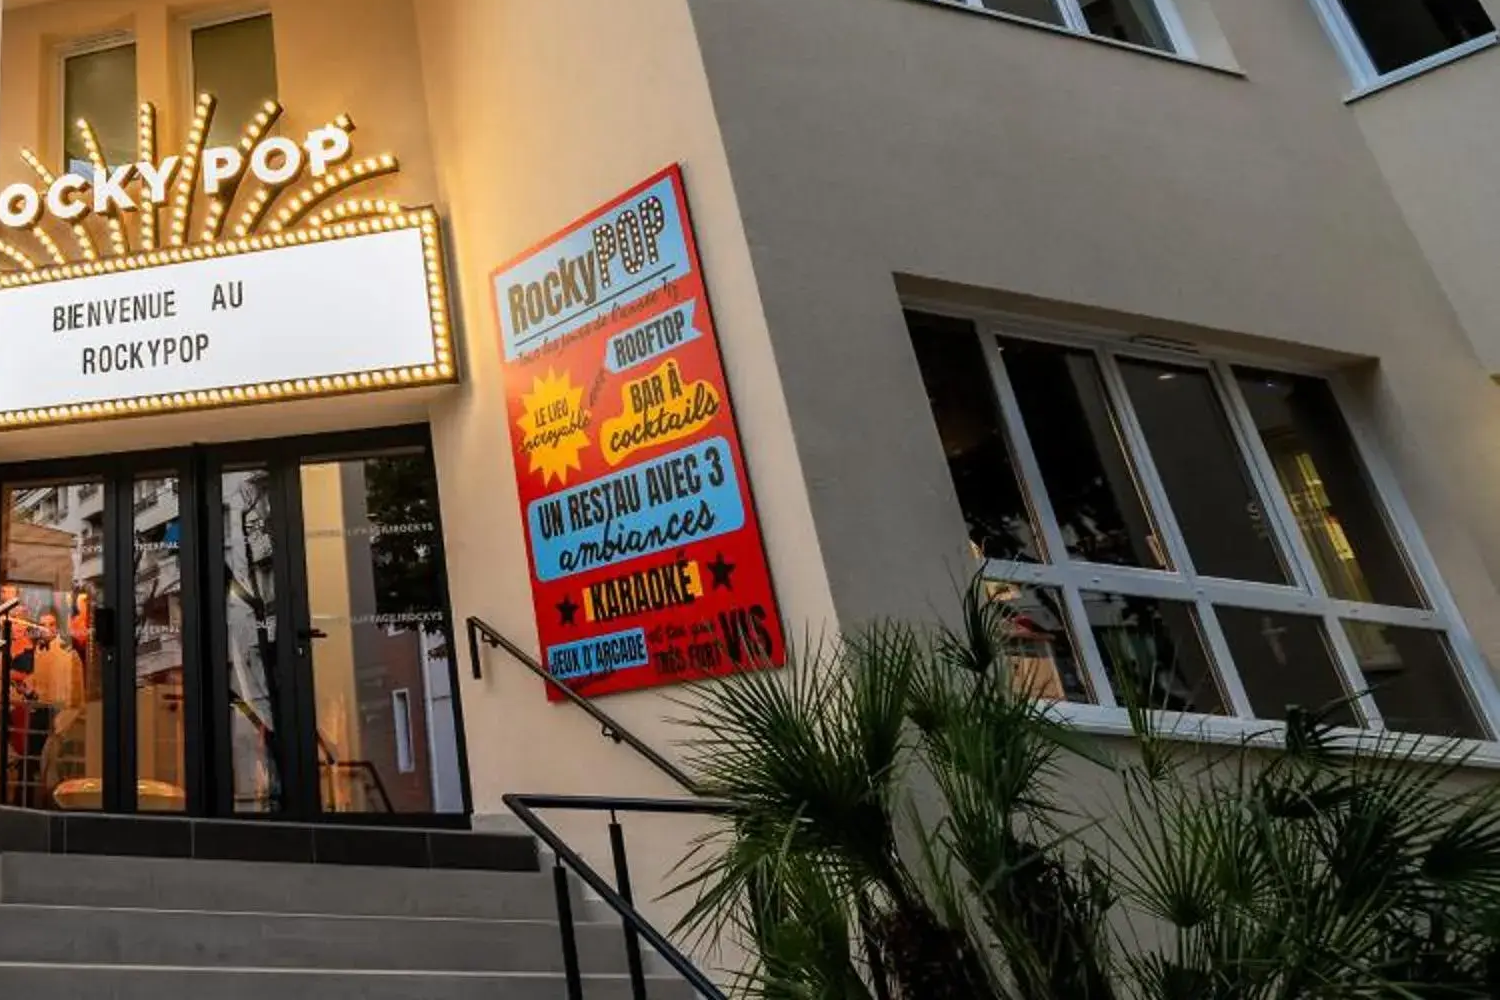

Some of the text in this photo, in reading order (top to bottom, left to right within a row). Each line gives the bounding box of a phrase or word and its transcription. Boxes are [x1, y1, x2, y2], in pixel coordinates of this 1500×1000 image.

[201, 127, 351, 195] POP
[53, 280, 244, 333] BIENVENUE AU
[82, 333, 210, 376] ROCKYPOP
[613, 309, 685, 368] ROOFTOP
[533, 397, 569, 428] LE LIEU
[630, 374, 665, 413] BAR
[667, 361, 683, 398] À
[519, 409, 590, 452] incroyable
[609, 382, 720, 452] cocktails
[537, 446, 725, 540] UN RESTAU AVEC 3
[559, 499, 715, 572] ambiances
[589, 550, 695, 622] KARAOKÉ
[551, 648, 580, 677] JEUX
